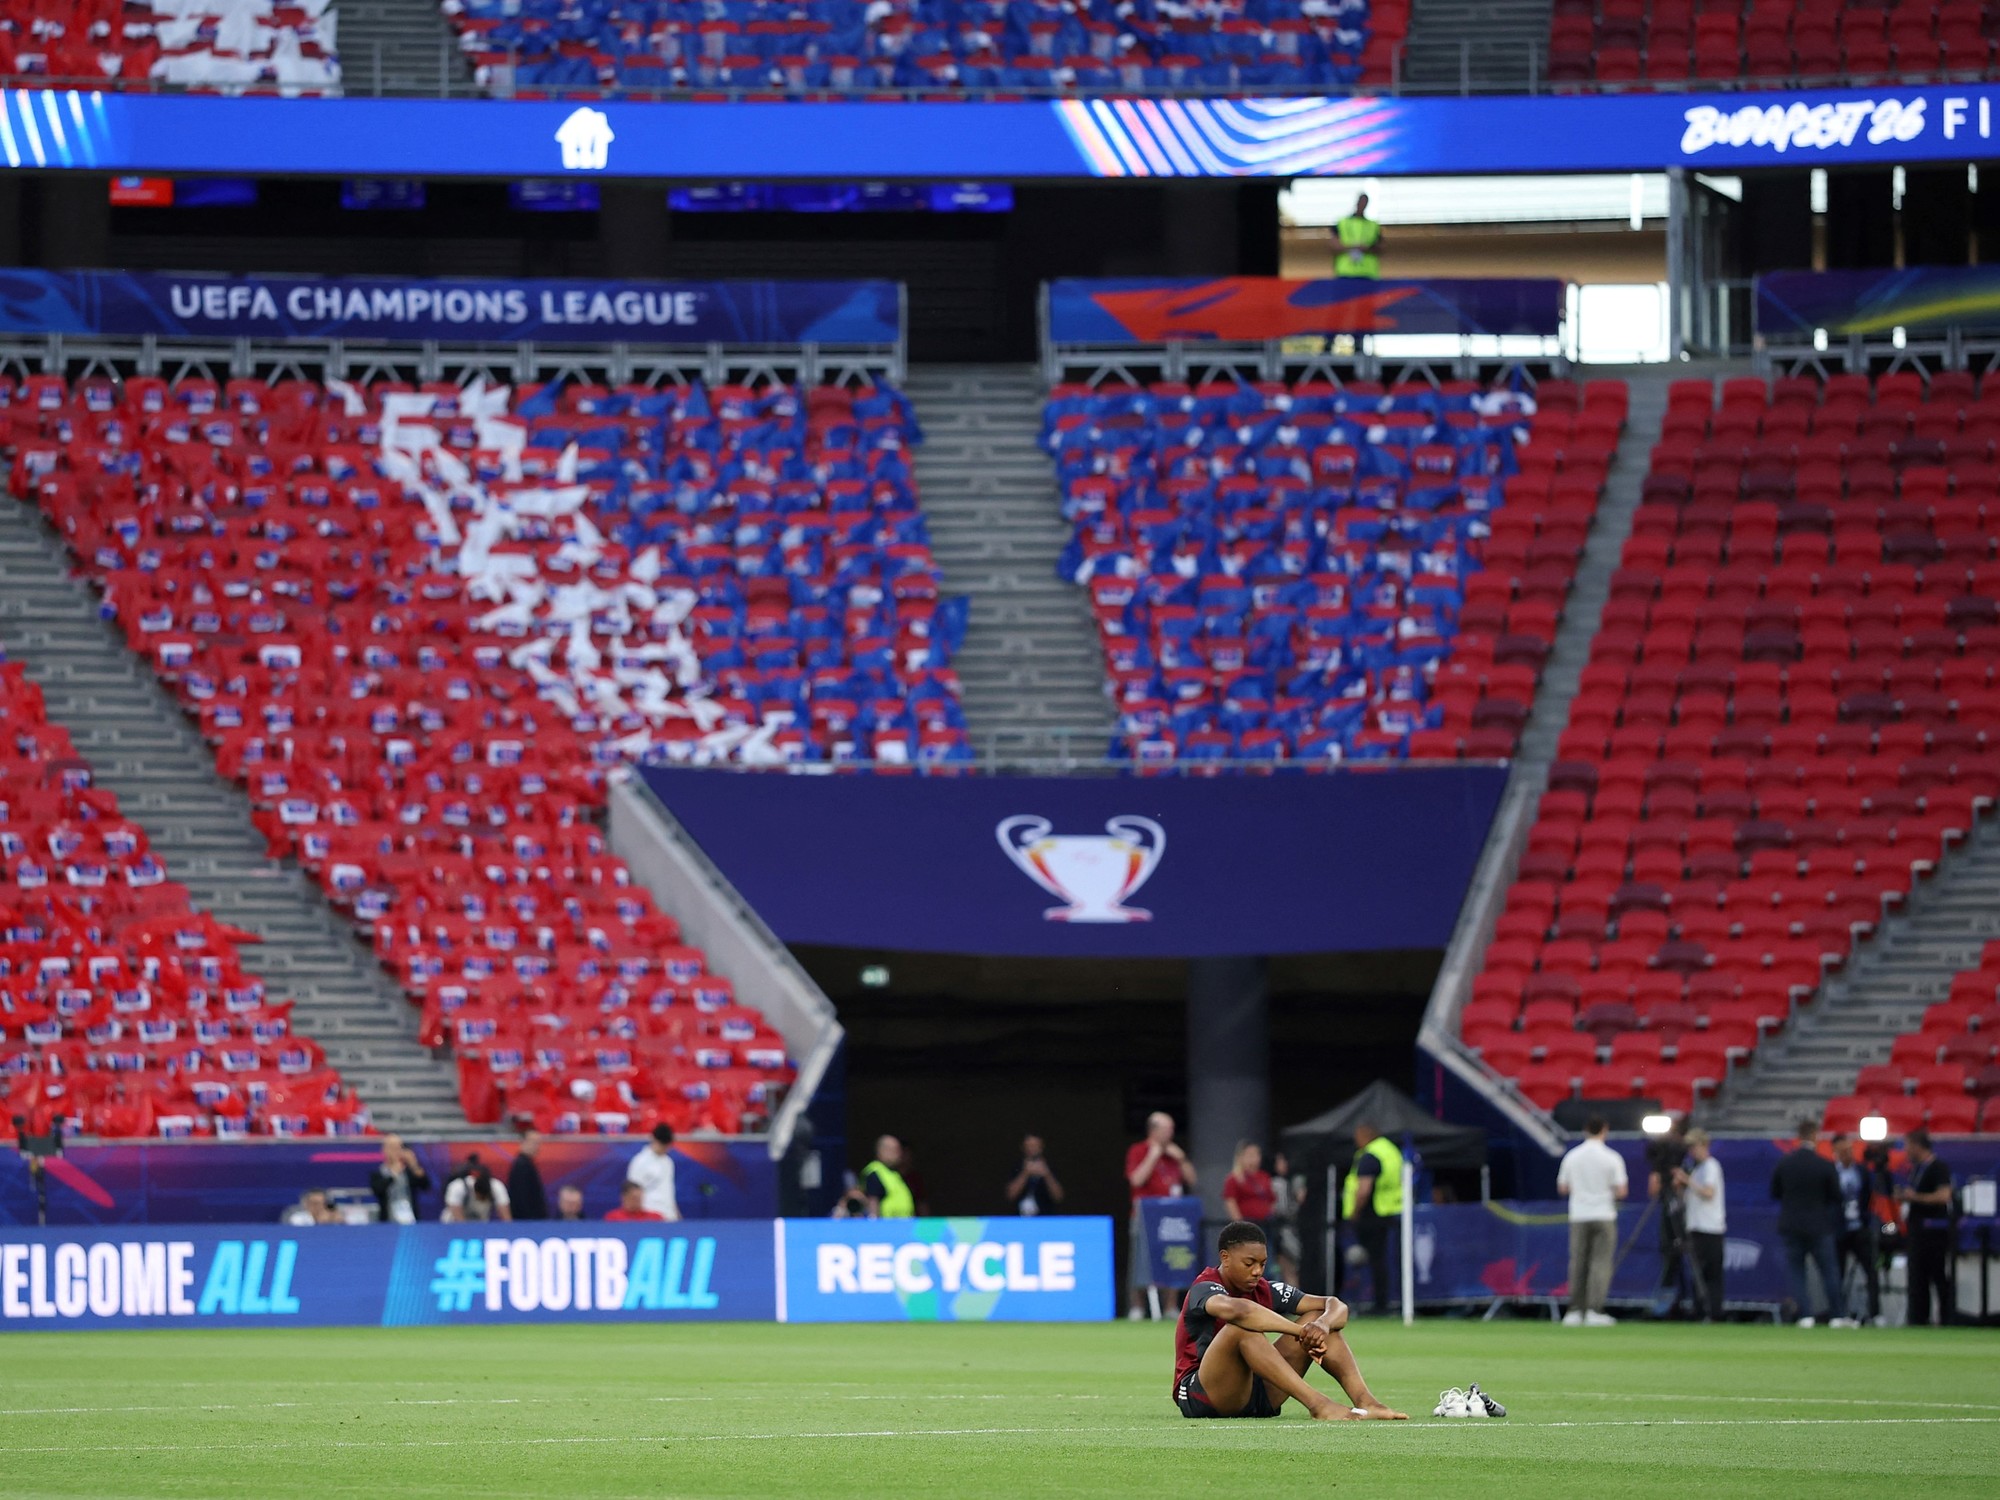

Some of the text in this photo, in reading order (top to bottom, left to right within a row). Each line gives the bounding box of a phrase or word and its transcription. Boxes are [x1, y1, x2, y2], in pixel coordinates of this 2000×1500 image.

[1866, 97, 1928, 143] 26
[170, 285, 698, 325] UEFA CHAMPIONS LEAGUE
[0, 1240, 301, 1318] ELCOME ALL
[816, 1241, 1076, 1293] RECYCLE
